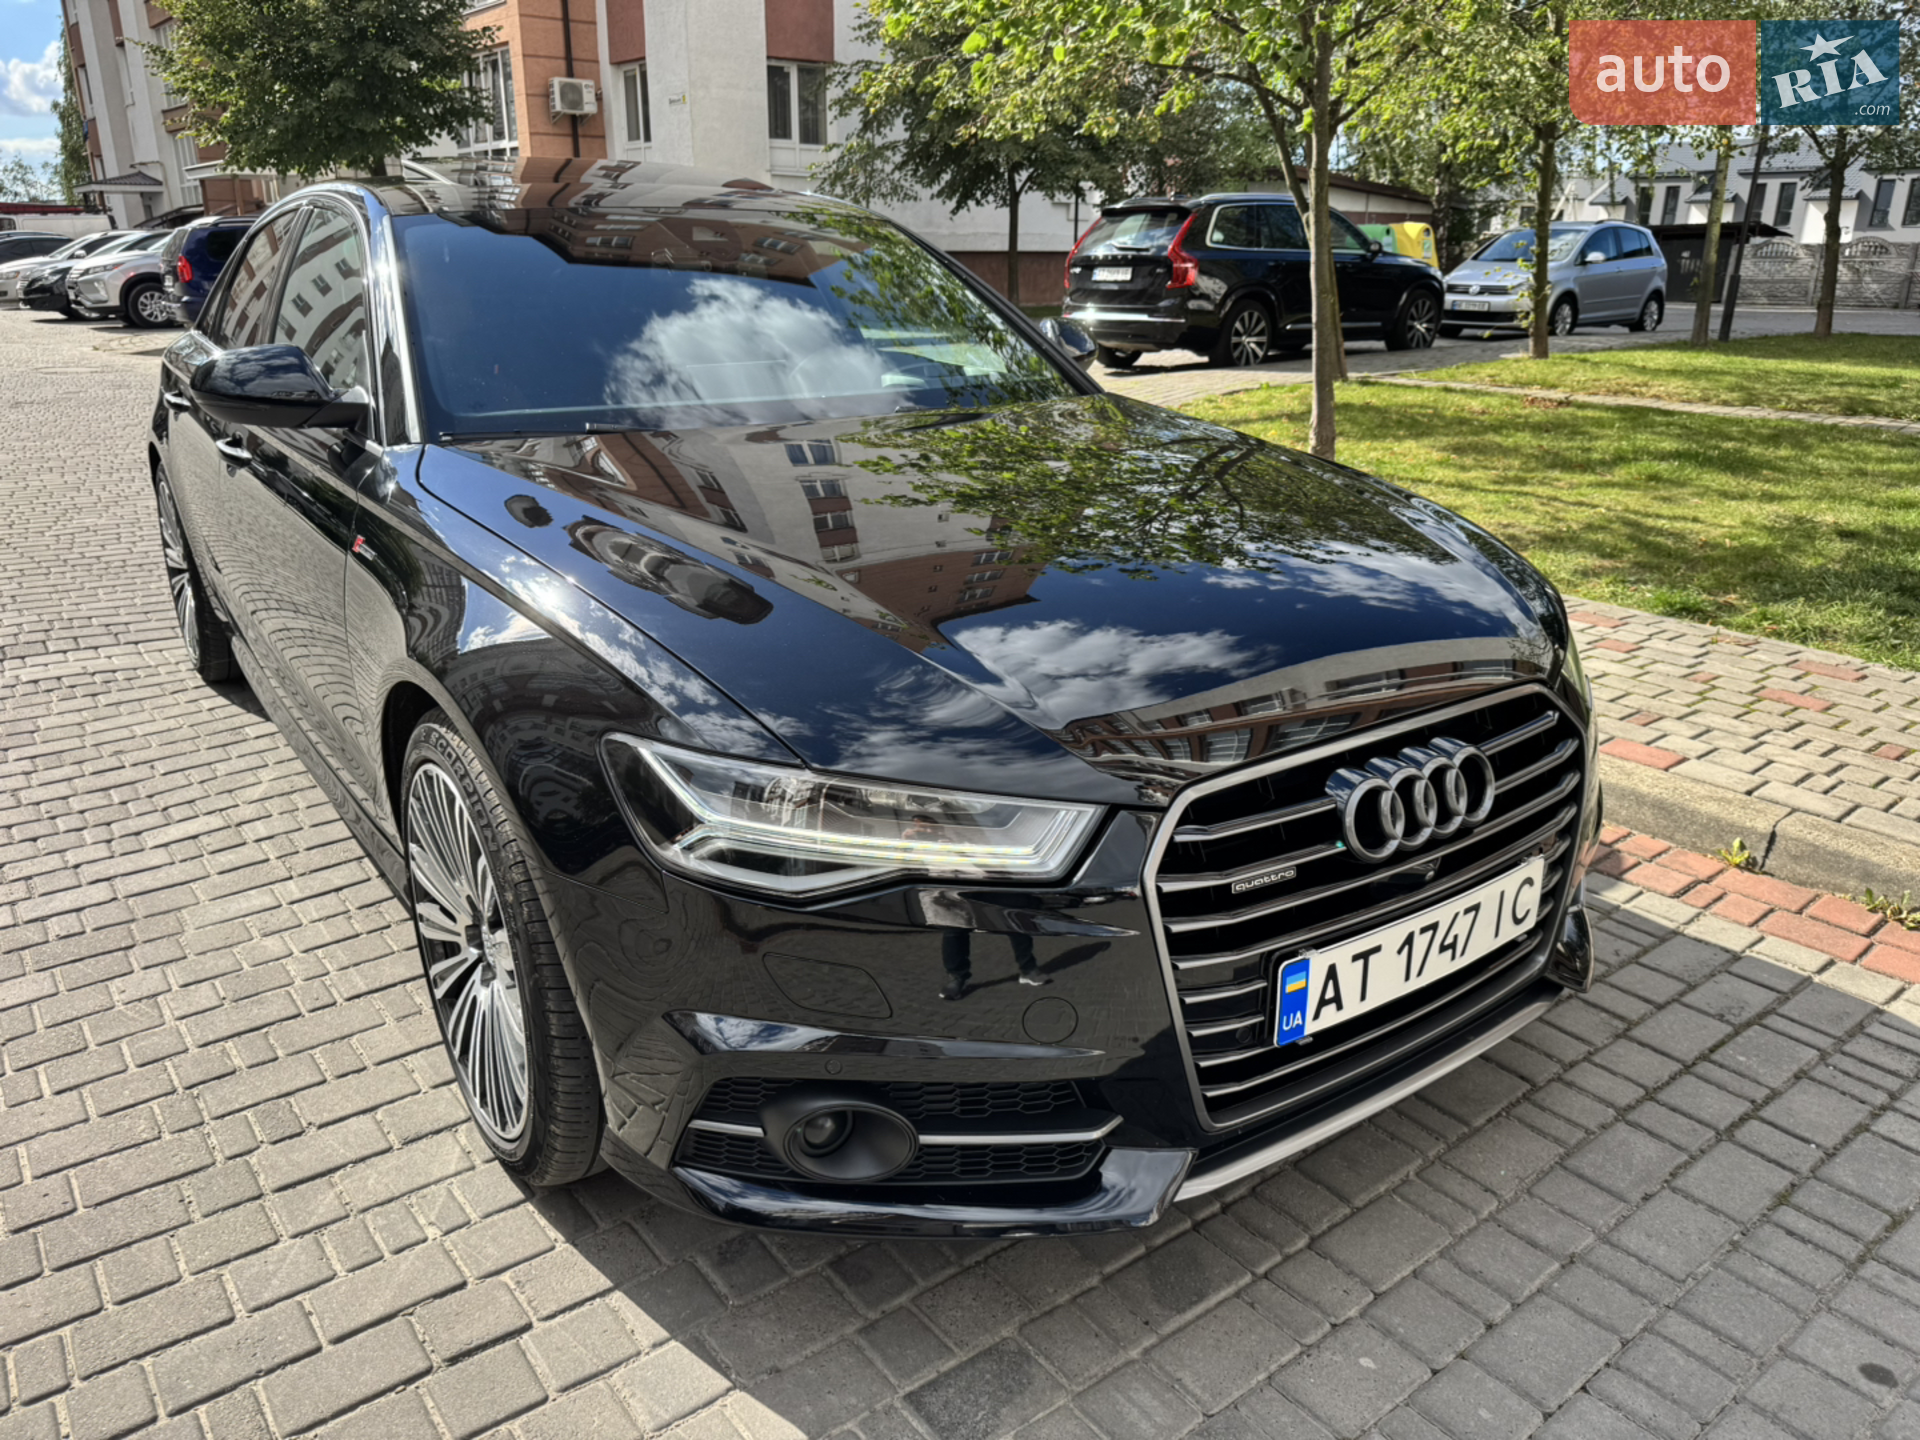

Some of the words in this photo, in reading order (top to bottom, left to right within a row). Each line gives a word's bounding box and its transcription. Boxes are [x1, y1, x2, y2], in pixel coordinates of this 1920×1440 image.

[429, 732, 498, 852] SCORPION
[1235, 870, 1294, 891] quattro
[1312, 944, 1382, 1021] AT
[1396, 902, 1481, 982] 1747
[1494, 876, 1534, 939] IC
[1282, 1010, 1303, 1031] UA
